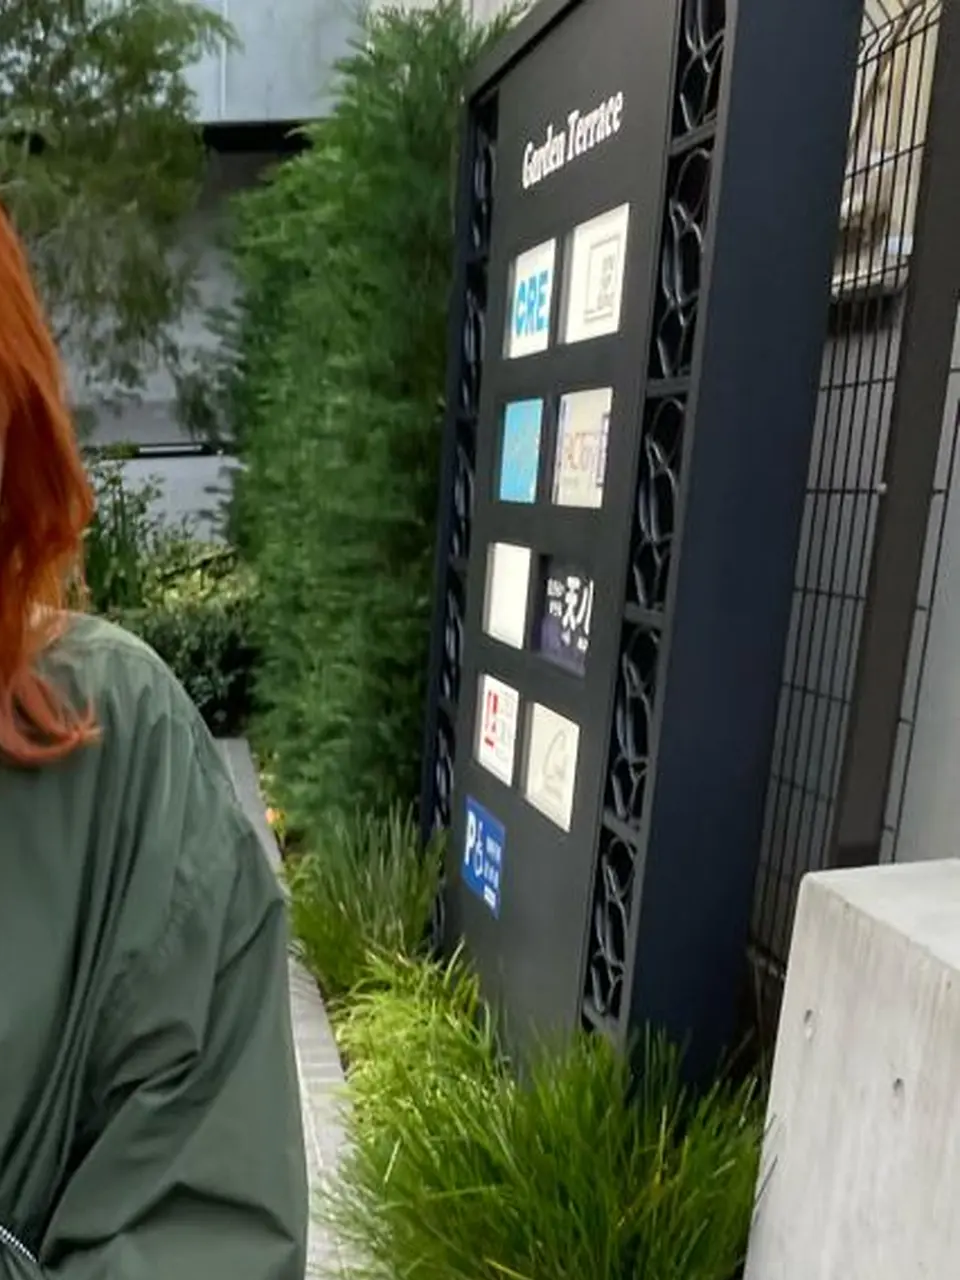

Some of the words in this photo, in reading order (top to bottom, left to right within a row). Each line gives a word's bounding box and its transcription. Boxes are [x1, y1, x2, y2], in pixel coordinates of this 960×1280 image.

[522, 124, 566, 189] Garden
[567, 91, 623, 161] Terrace
[464, 810, 476, 866] P
